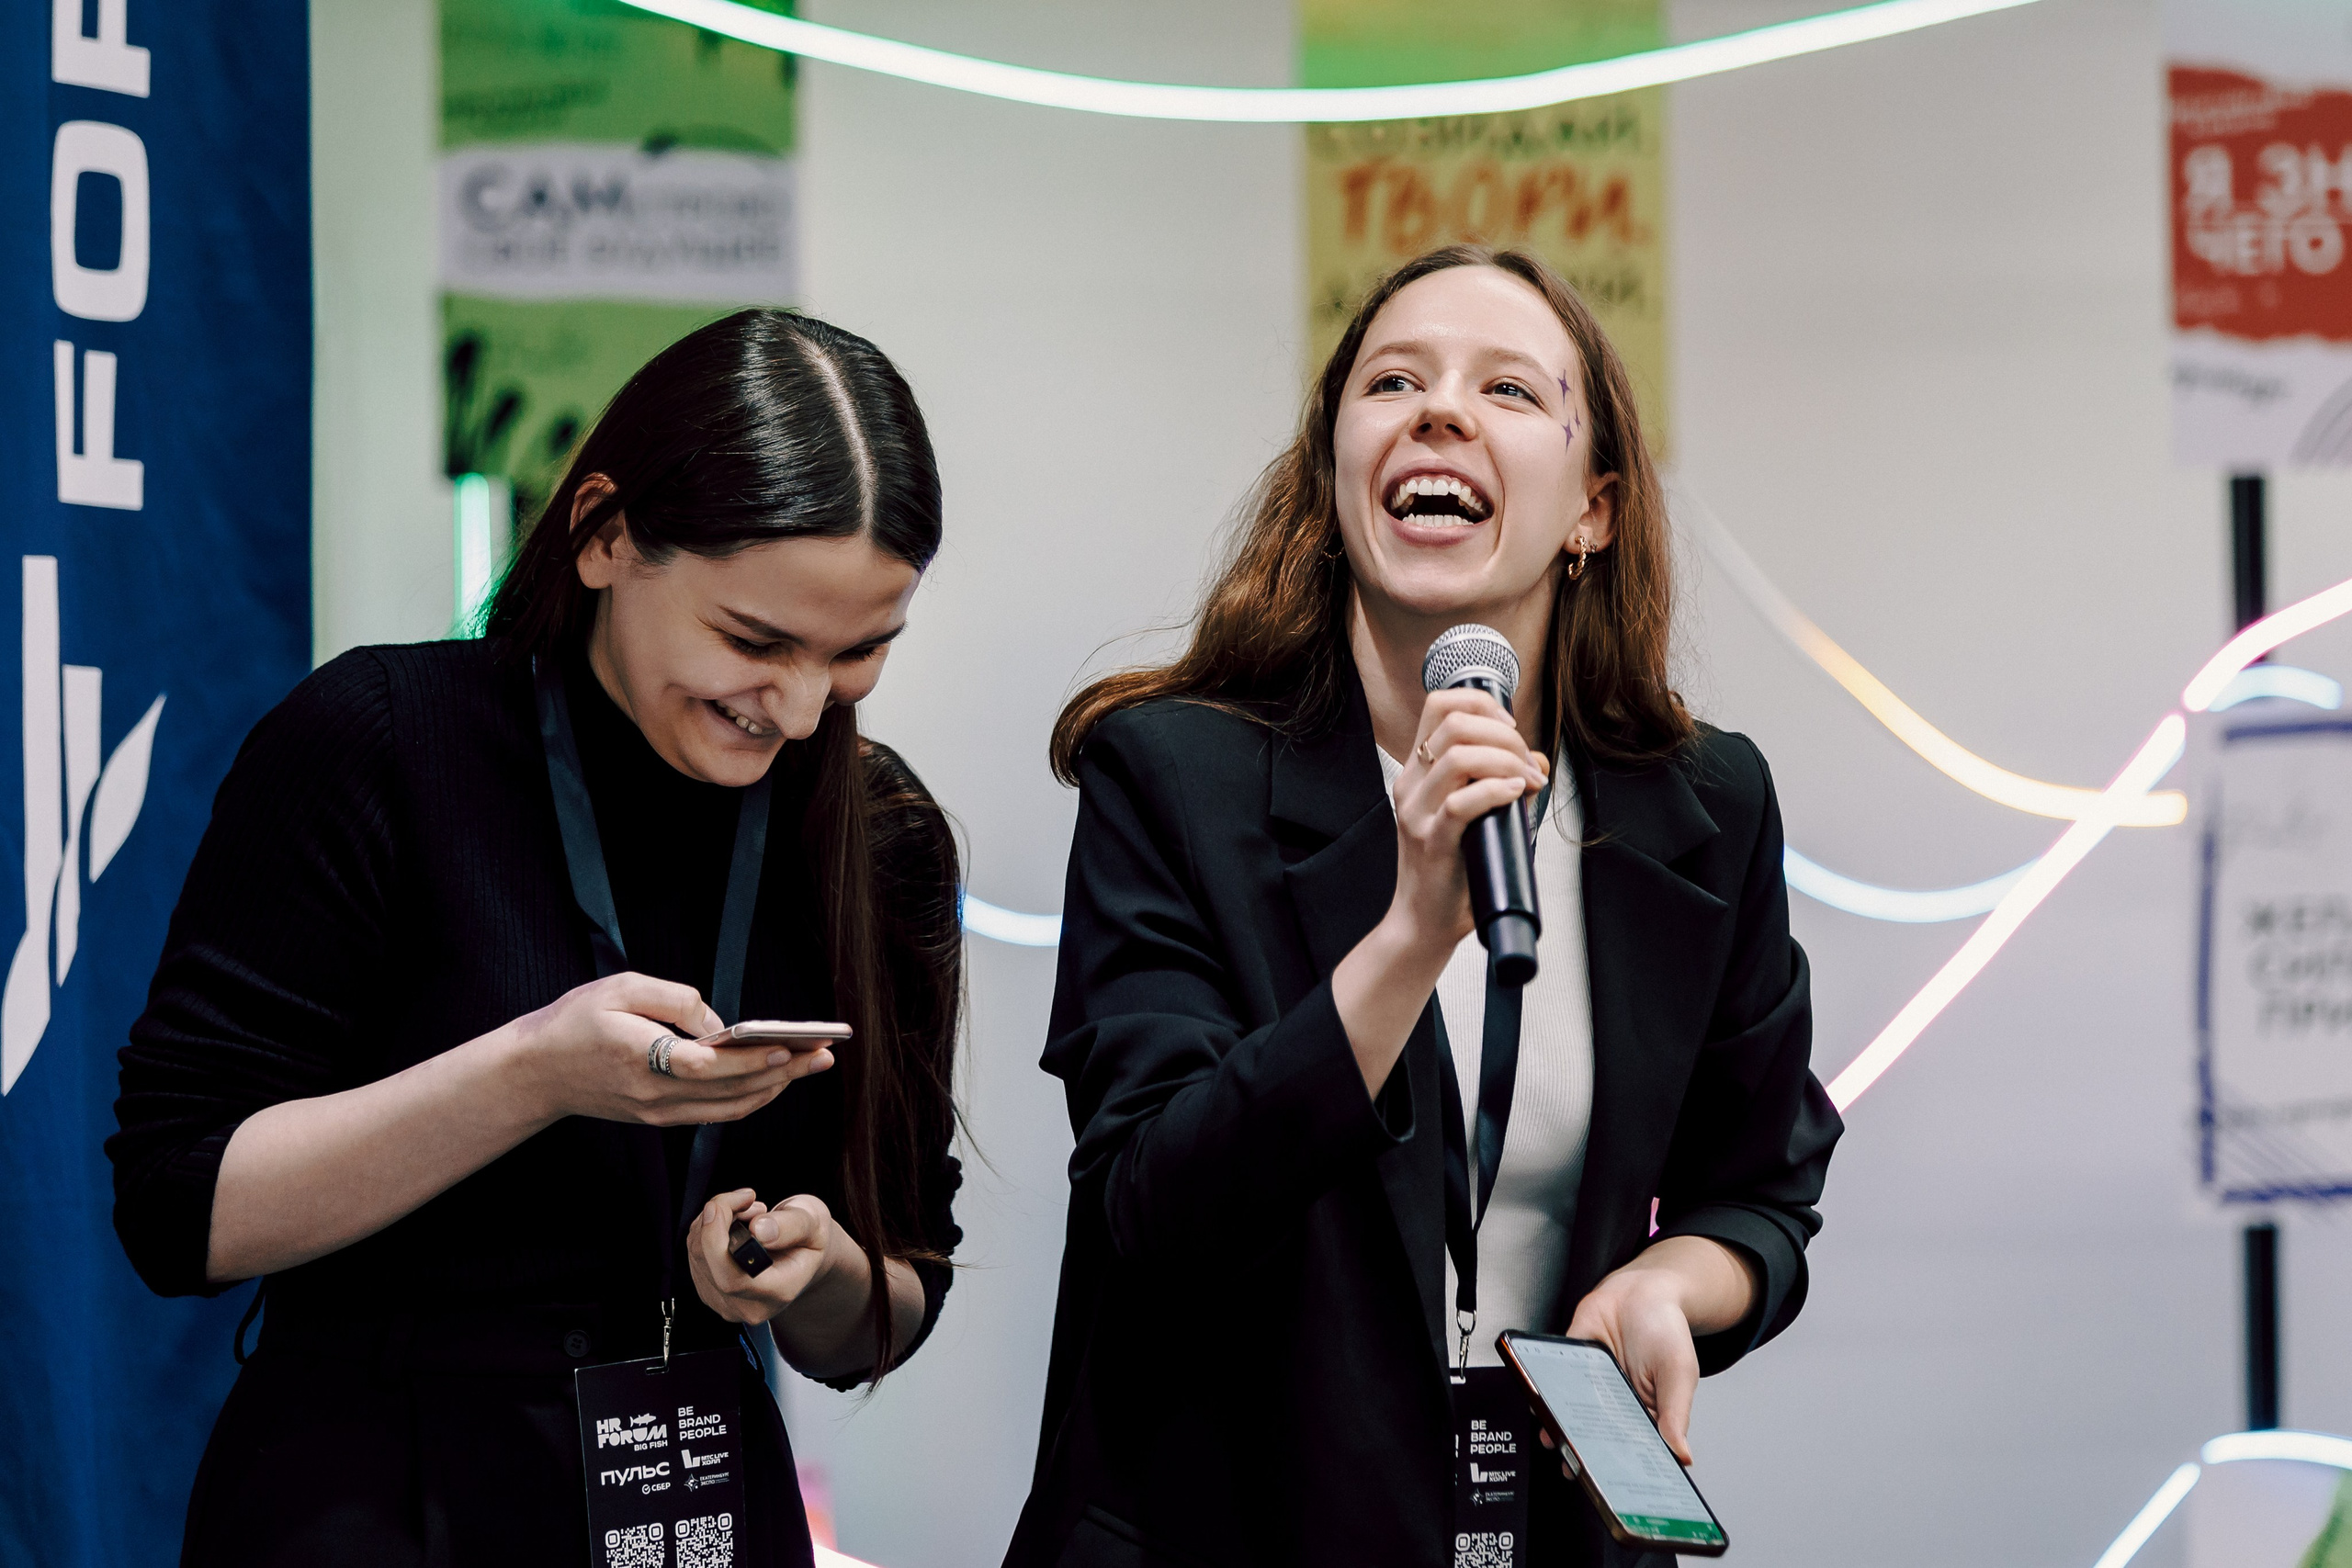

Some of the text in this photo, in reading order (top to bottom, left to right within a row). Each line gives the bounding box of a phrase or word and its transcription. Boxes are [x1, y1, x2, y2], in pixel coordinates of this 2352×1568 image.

[461, 162, 636, 235] САМ
[678, 1406, 694, 1417] BE
[596, 1417, 623, 1434] HR
[678, 1414, 721, 1429] BRAND
[1471, 1419, 1487, 1430] BE
[597, 1424, 668, 1449] FORUM
[679, 1425, 727, 1441] PEOPLE
[1471, 1431, 1512, 1442] BRAND
[634, 1439, 668, 1451] BIG FISH
[1470, 1443, 1517, 1454] PEOPLE
[651, 1482, 671, 1491] СБЕР
